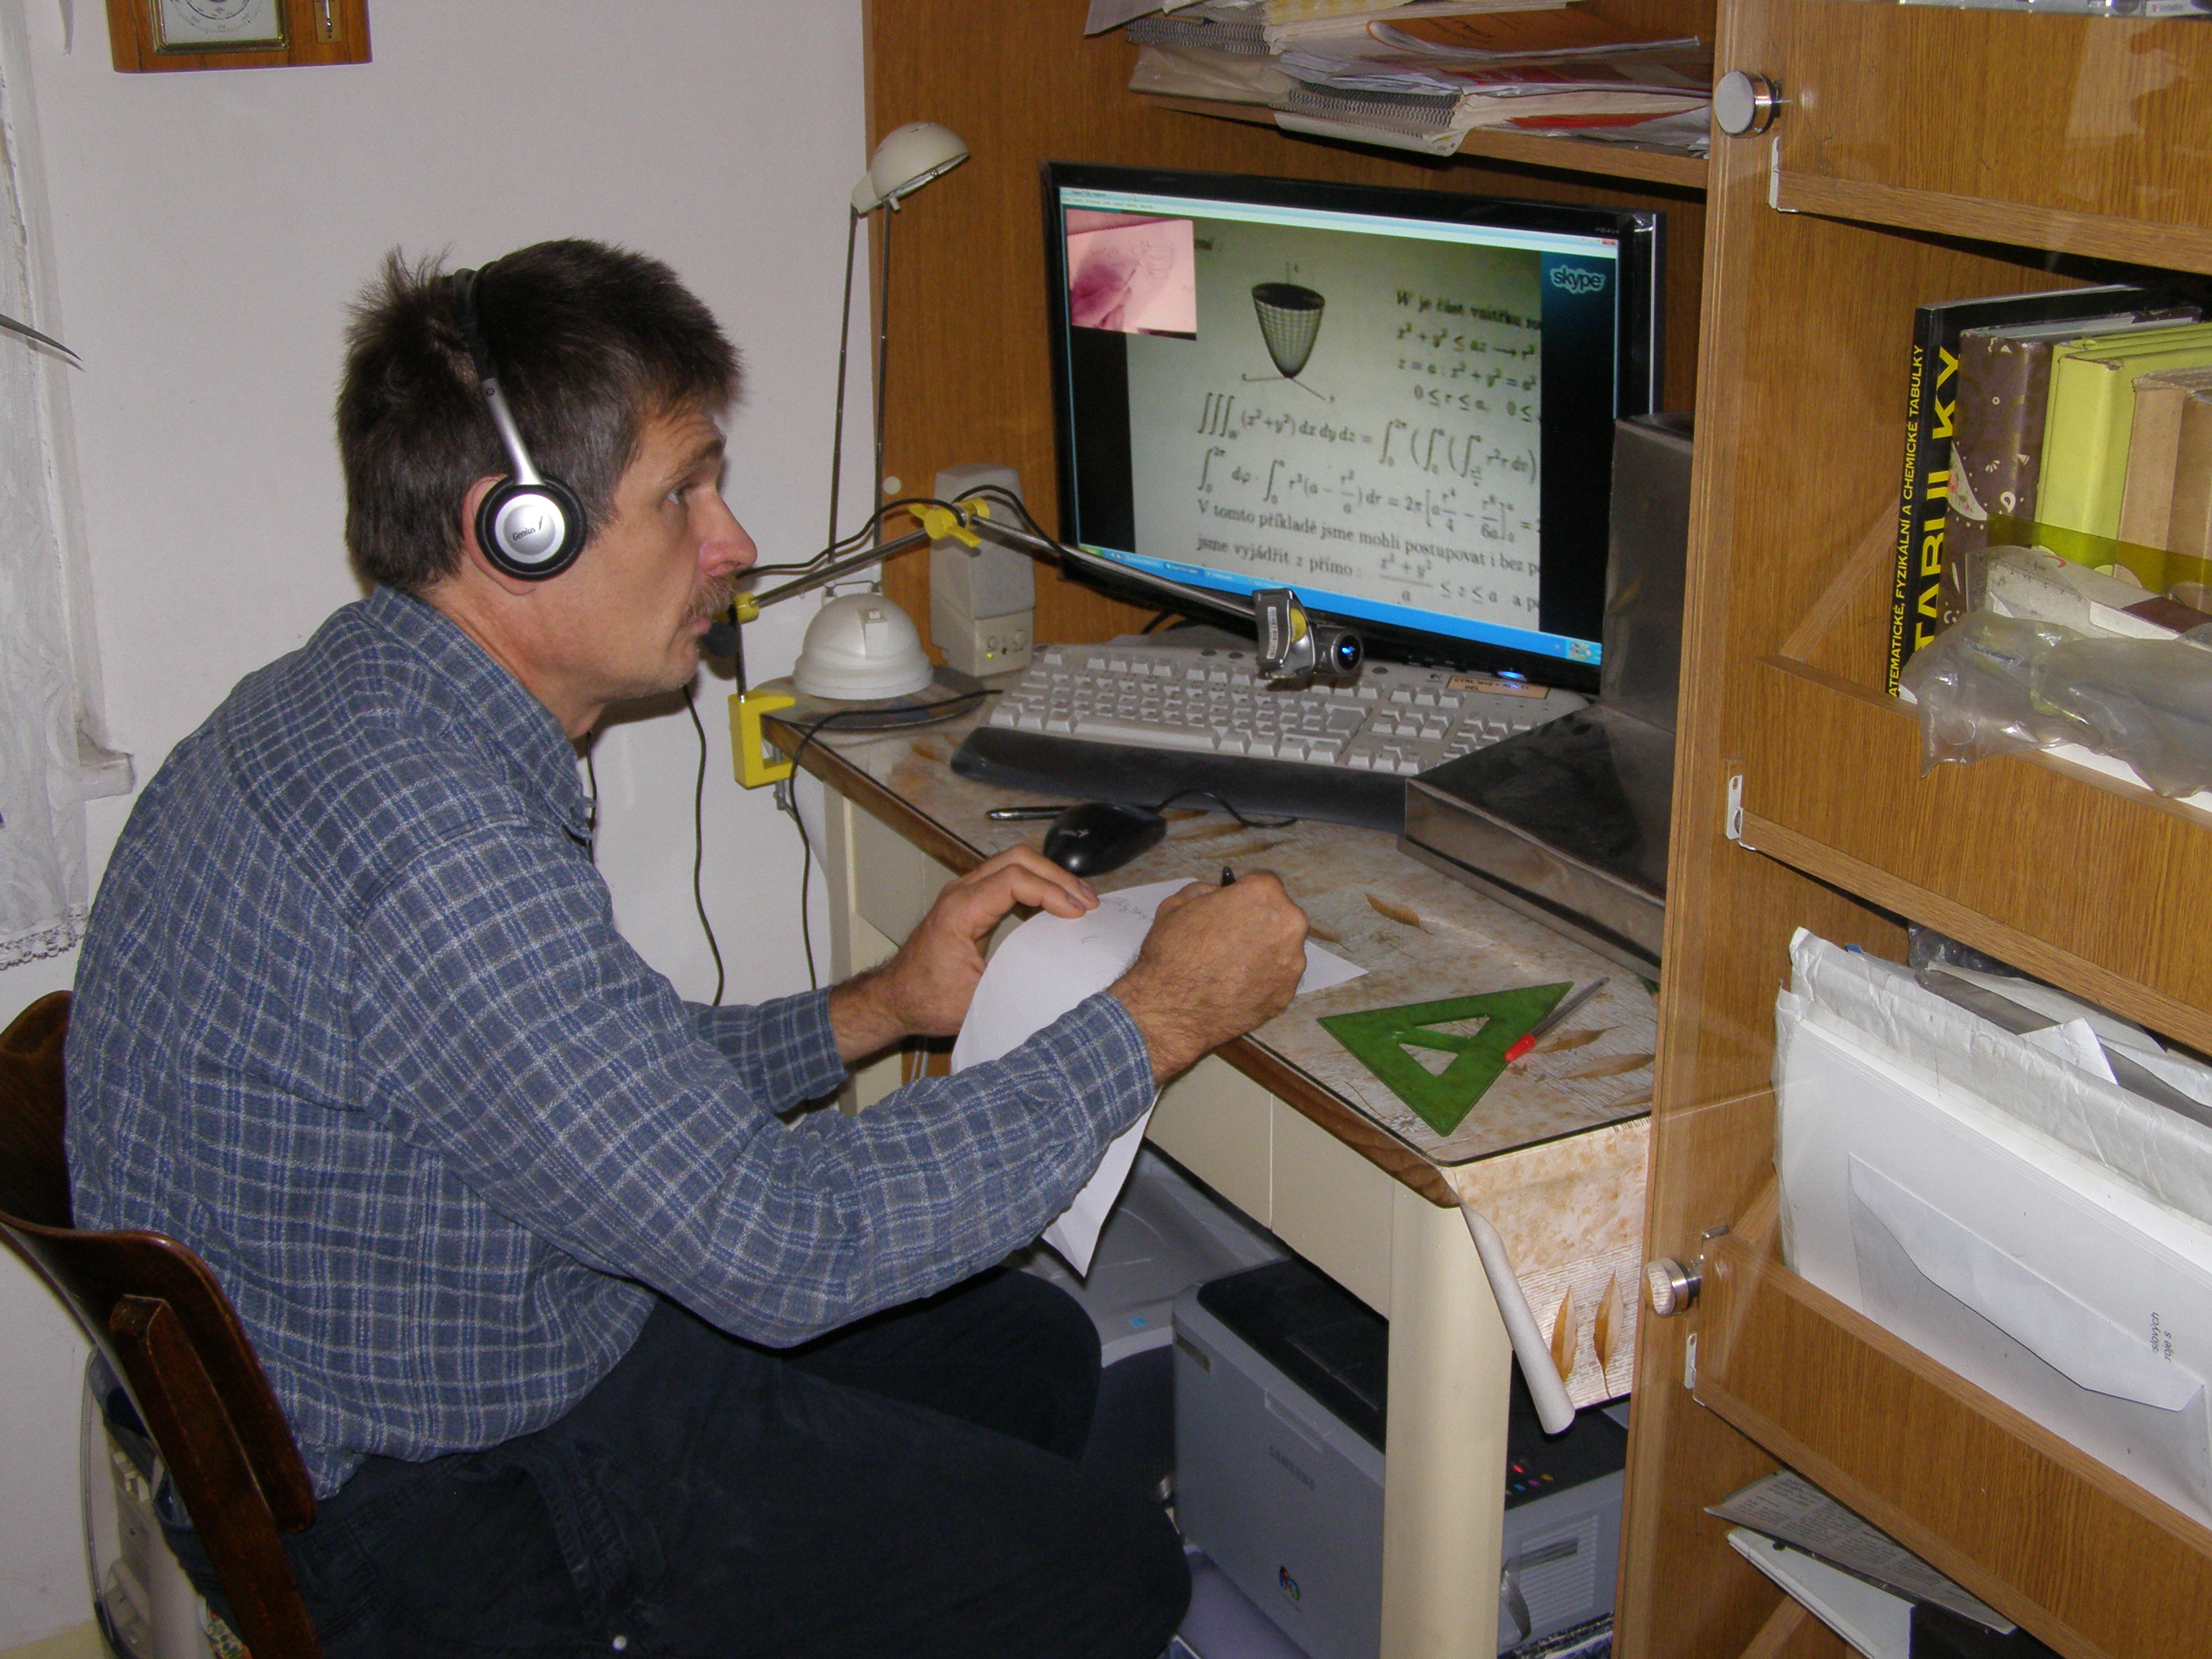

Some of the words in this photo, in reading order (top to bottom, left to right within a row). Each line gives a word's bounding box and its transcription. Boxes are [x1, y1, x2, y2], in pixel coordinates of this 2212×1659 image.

[1552, 265, 1604, 293] skype
[1909, 344, 1923, 418] TABULKY
[1902, 421, 1918, 500] CHEMICKÉ
[512, 526, 536, 541] Genius
[1213, 505, 1256, 523] tomto
[1320, 521, 1354, 540] jsme
[1405, 540, 1485, 565] postupovat
[1902, 504, 1912, 516] A
[1895, 518, 1911, 600] FYZIKÁLNÍ
[1888, 603, 1906, 698] ATEMATICKÉ,
